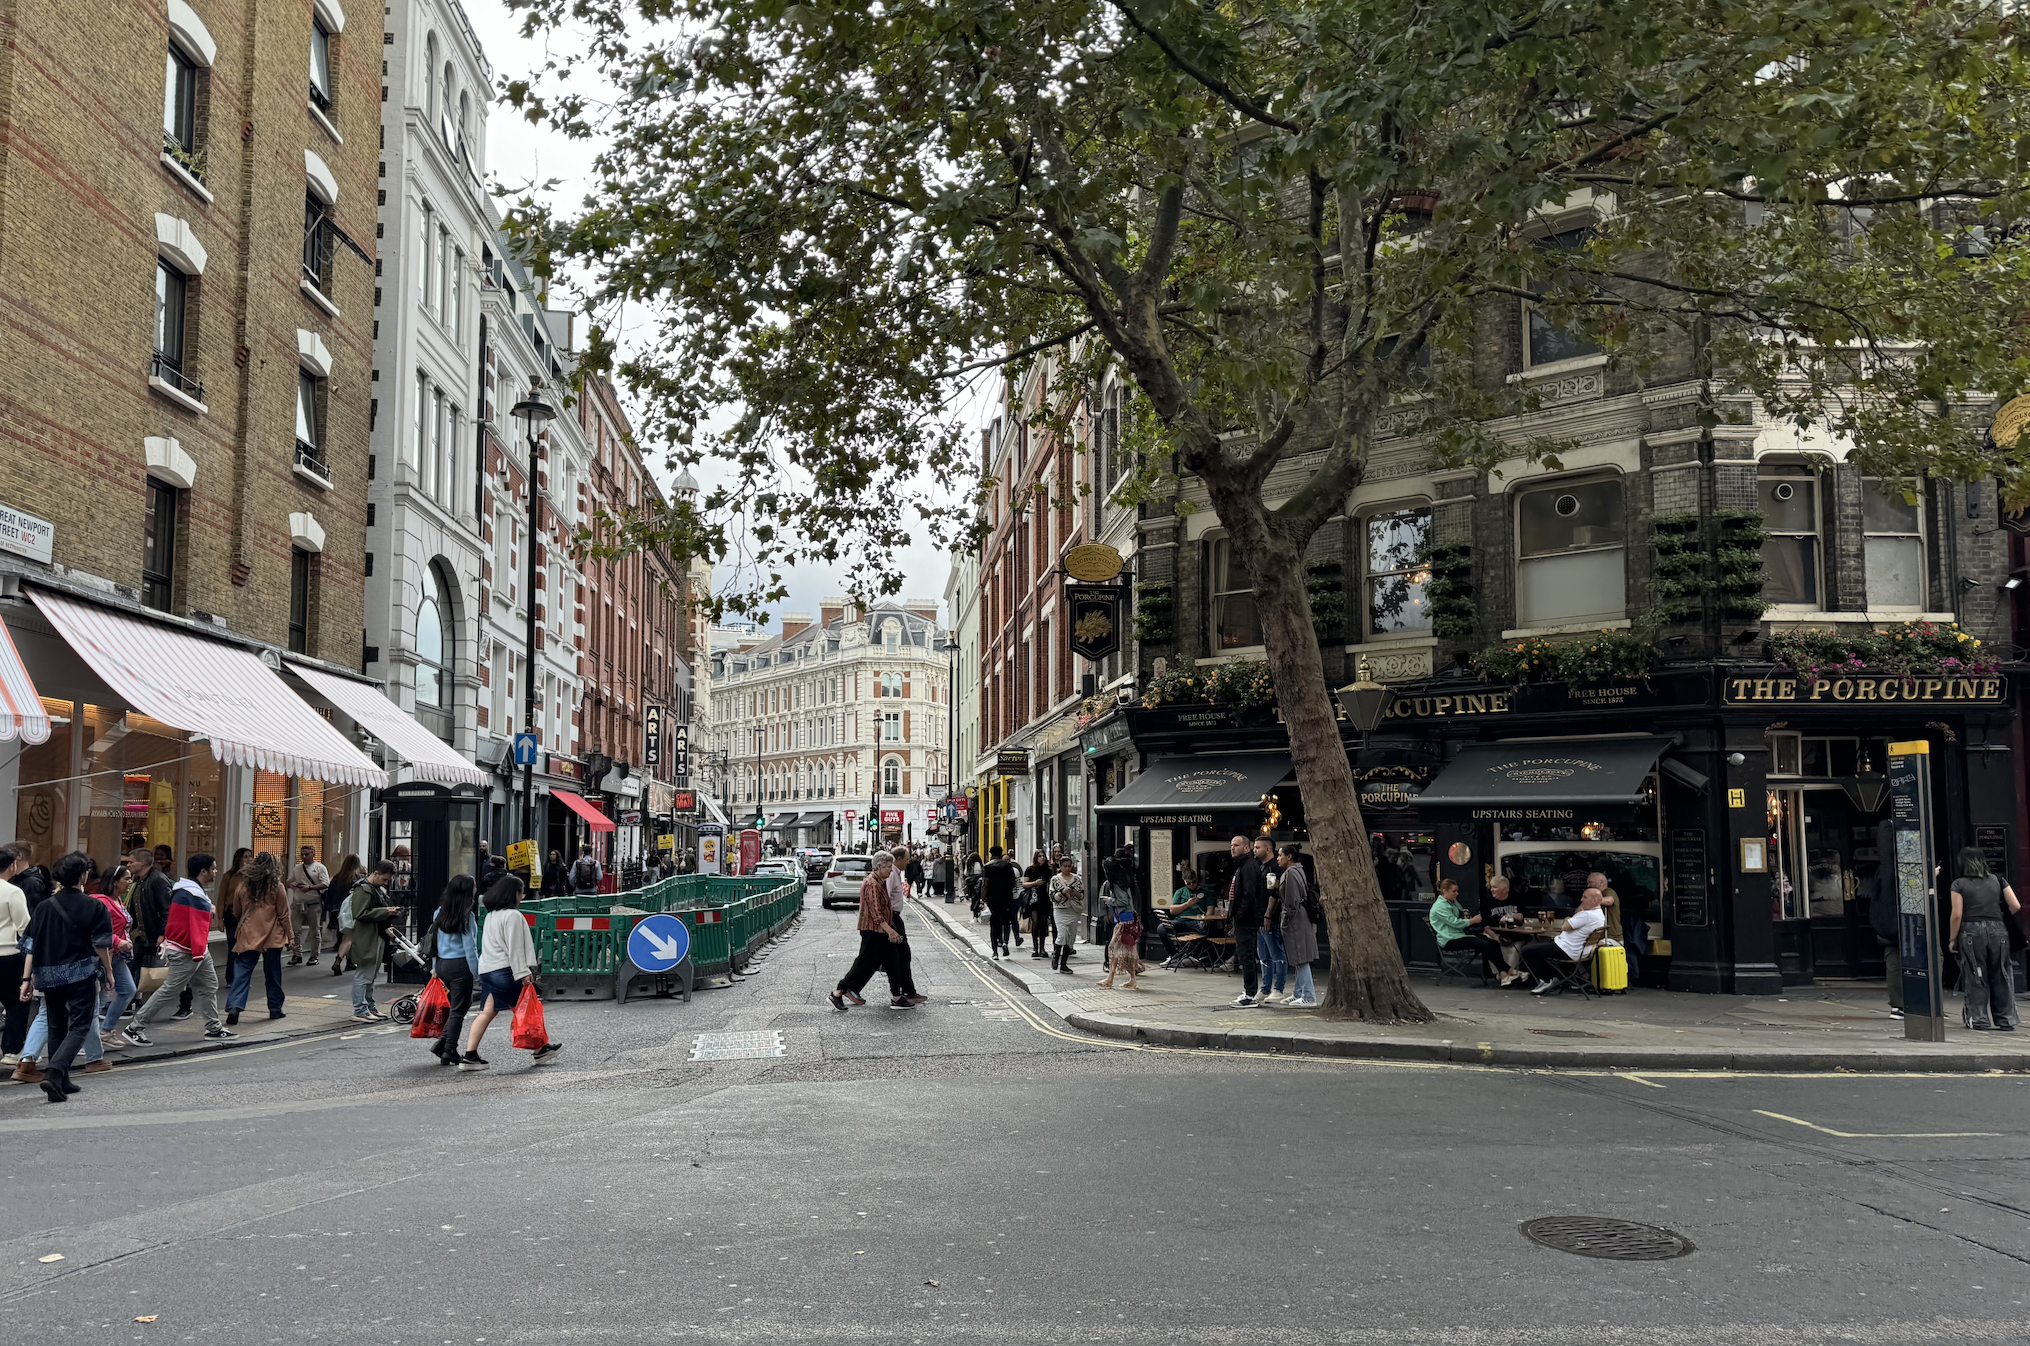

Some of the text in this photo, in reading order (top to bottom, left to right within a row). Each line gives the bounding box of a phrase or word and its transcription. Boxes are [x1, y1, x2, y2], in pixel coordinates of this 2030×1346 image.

[1998, 411, 2030, 436] NICHOLS
[0, 510, 50, 538] REAT NEWPORT
[0, 523, 36, 545] TREET WC2
[1567, 687, 1638, 699] FREE HOUSE
[1731, 678, 2001, 700] THE PORCUPINE
[1178, 712, 1227, 722] FREE HOUSE
[647, 708, 659, 762] ARTS
[677, 728, 688, 774] ARTS
[1487, 757, 1602, 773] THE PORCUPINE
[1164, 773, 1190, 783] THE
[1380, 783, 1400, 792] THE
[1731, 790, 1742, 806] H
[1140, 815, 1177, 823] UPSTAIRS
[1472, 810, 1573, 819] UPSTAIRS SEATING
